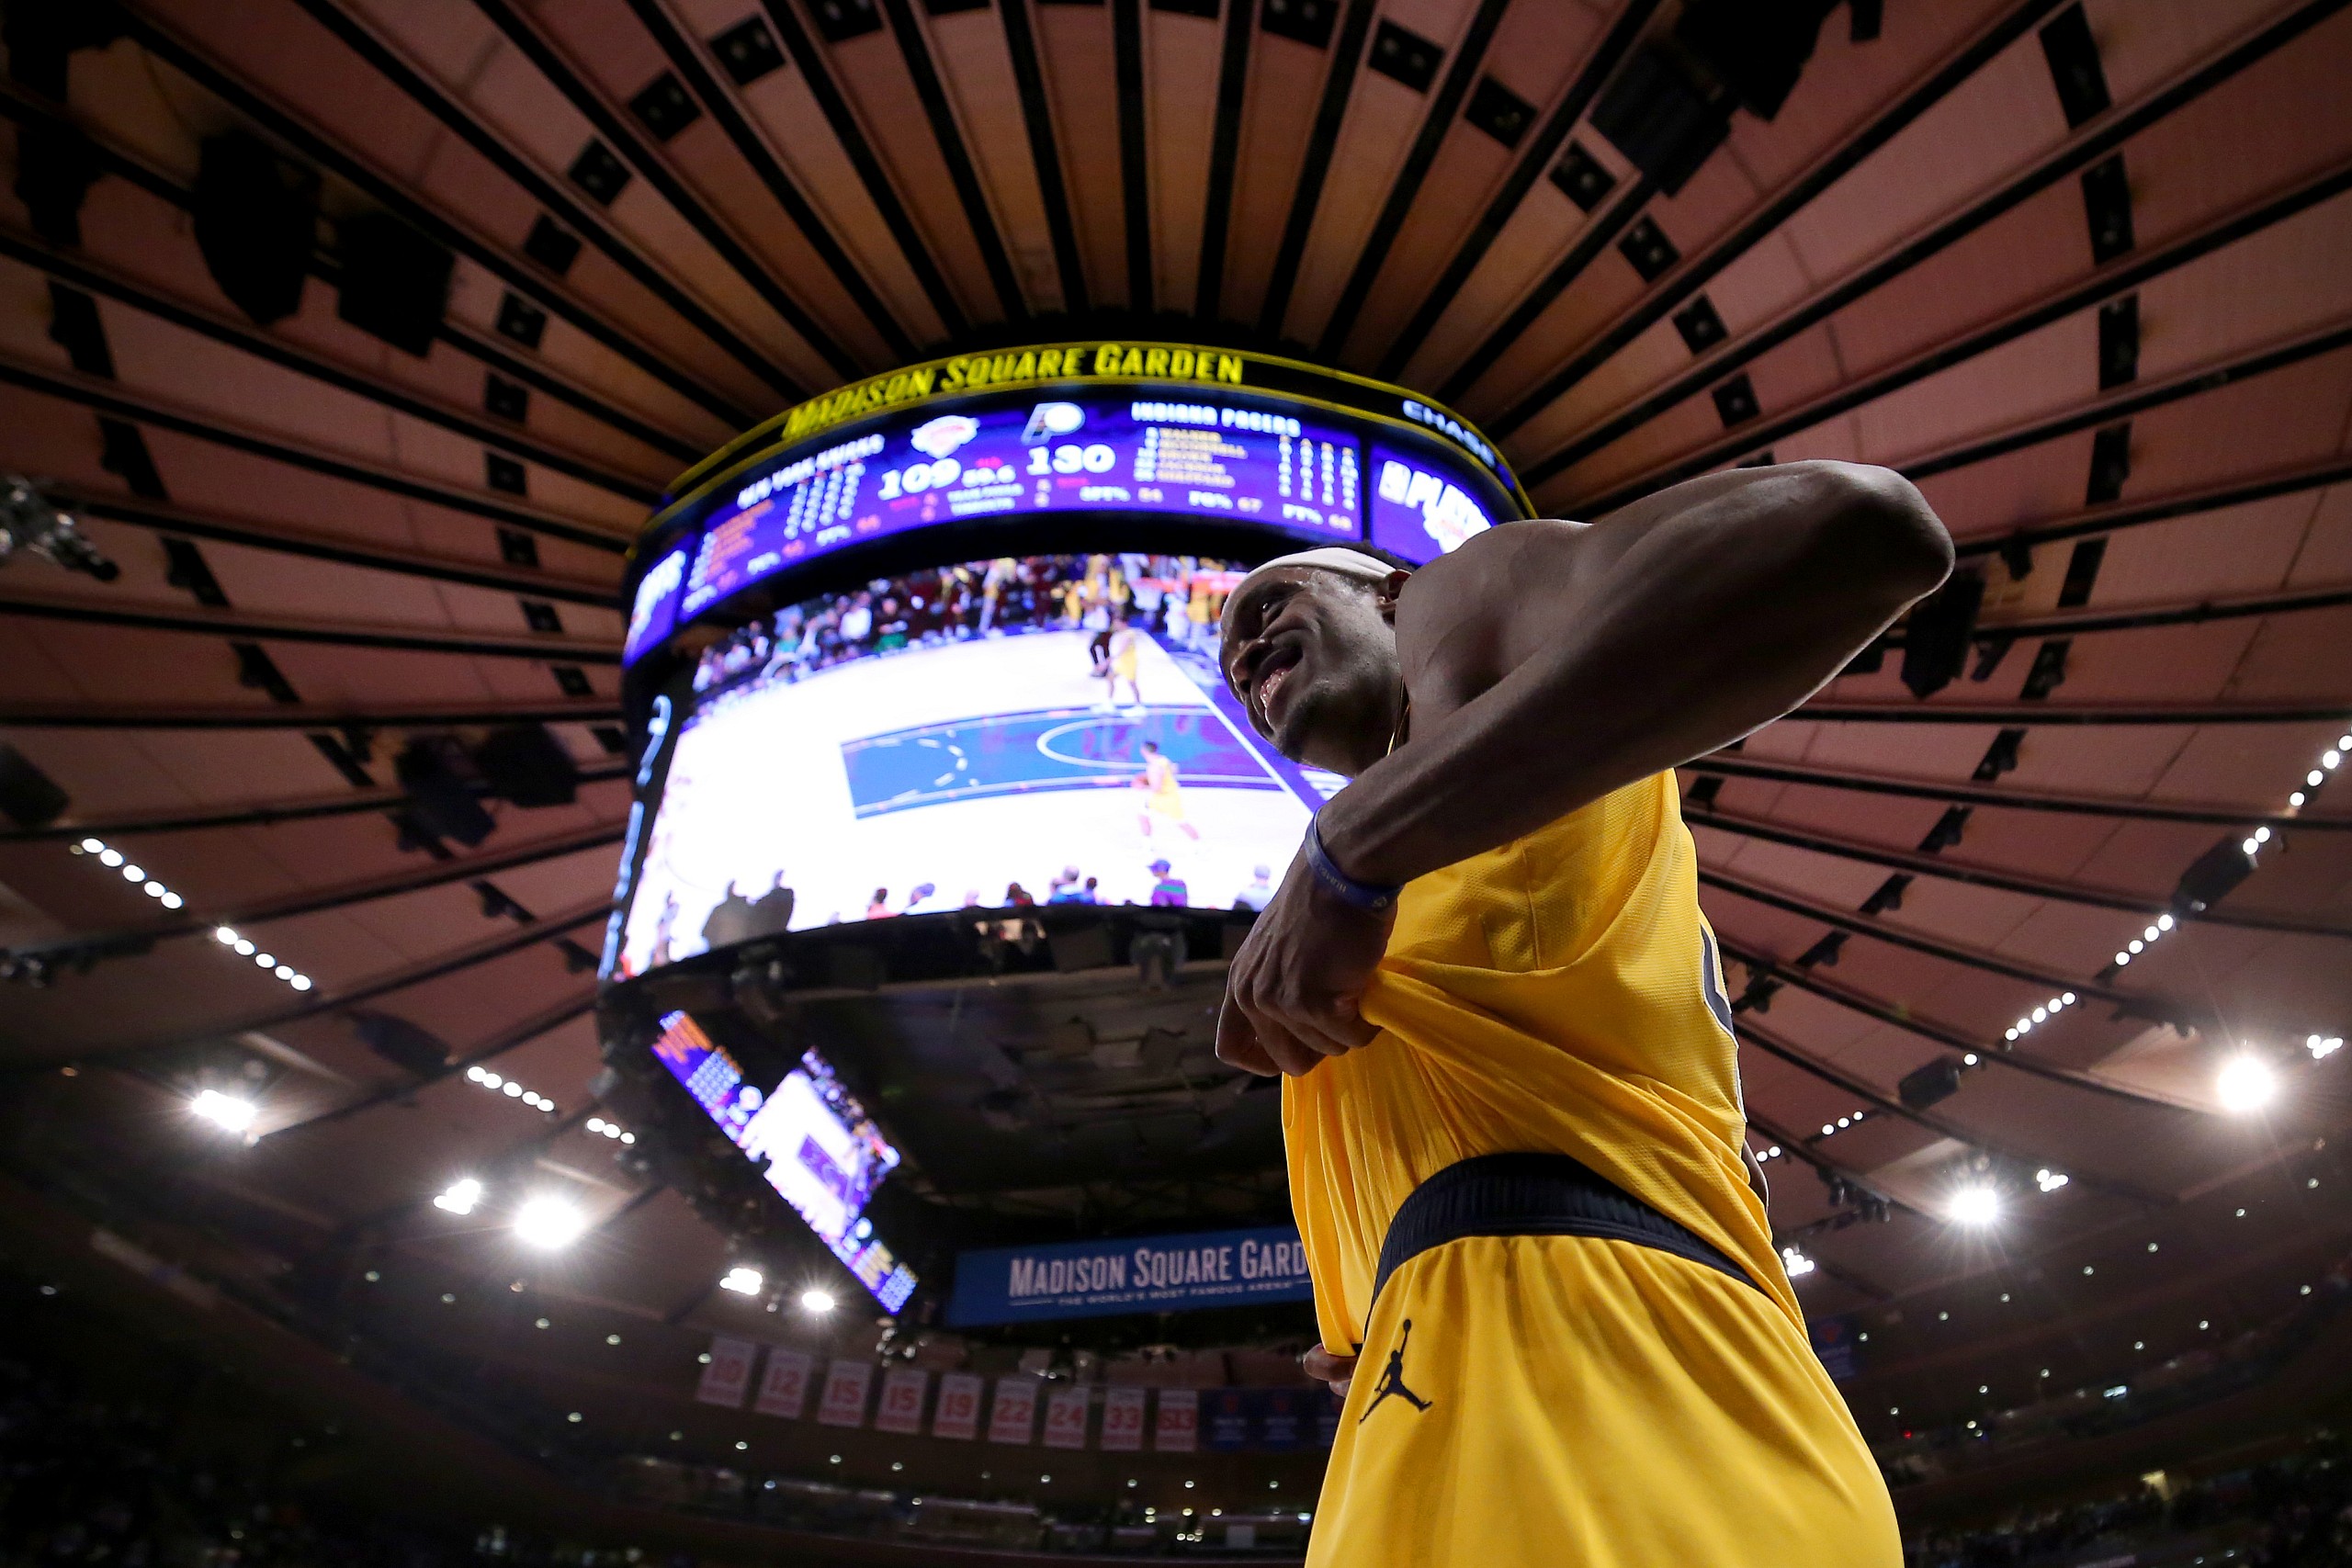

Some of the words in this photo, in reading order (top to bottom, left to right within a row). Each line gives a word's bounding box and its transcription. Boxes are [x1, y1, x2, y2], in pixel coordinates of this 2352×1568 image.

[780, 367, 934, 440] MADISON
[941, 347, 1085, 392] SQUARE
[1094, 343, 1244, 384] GARDEN
[1131, 400, 1217, 426] INDIANA
[1220, 407, 1302, 438] PACERS
[1026, 444, 1116, 475] 130
[877, 457, 962, 502] 109
[1009, 1255, 1126, 1298] MADISON
[1132, 1246, 1234, 1288] SQUARE
[1240, 1239, 1307, 1280] GARD
[832, 1380, 861, 1404] 15
[888, 1385, 917, 1411] 15
[943, 1393, 974, 1418] 19
[994, 1397, 1033, 1423] 22
[1050, 1402, 1085, 1427] 24
[1110, 1404, 1140, 1430] 33
